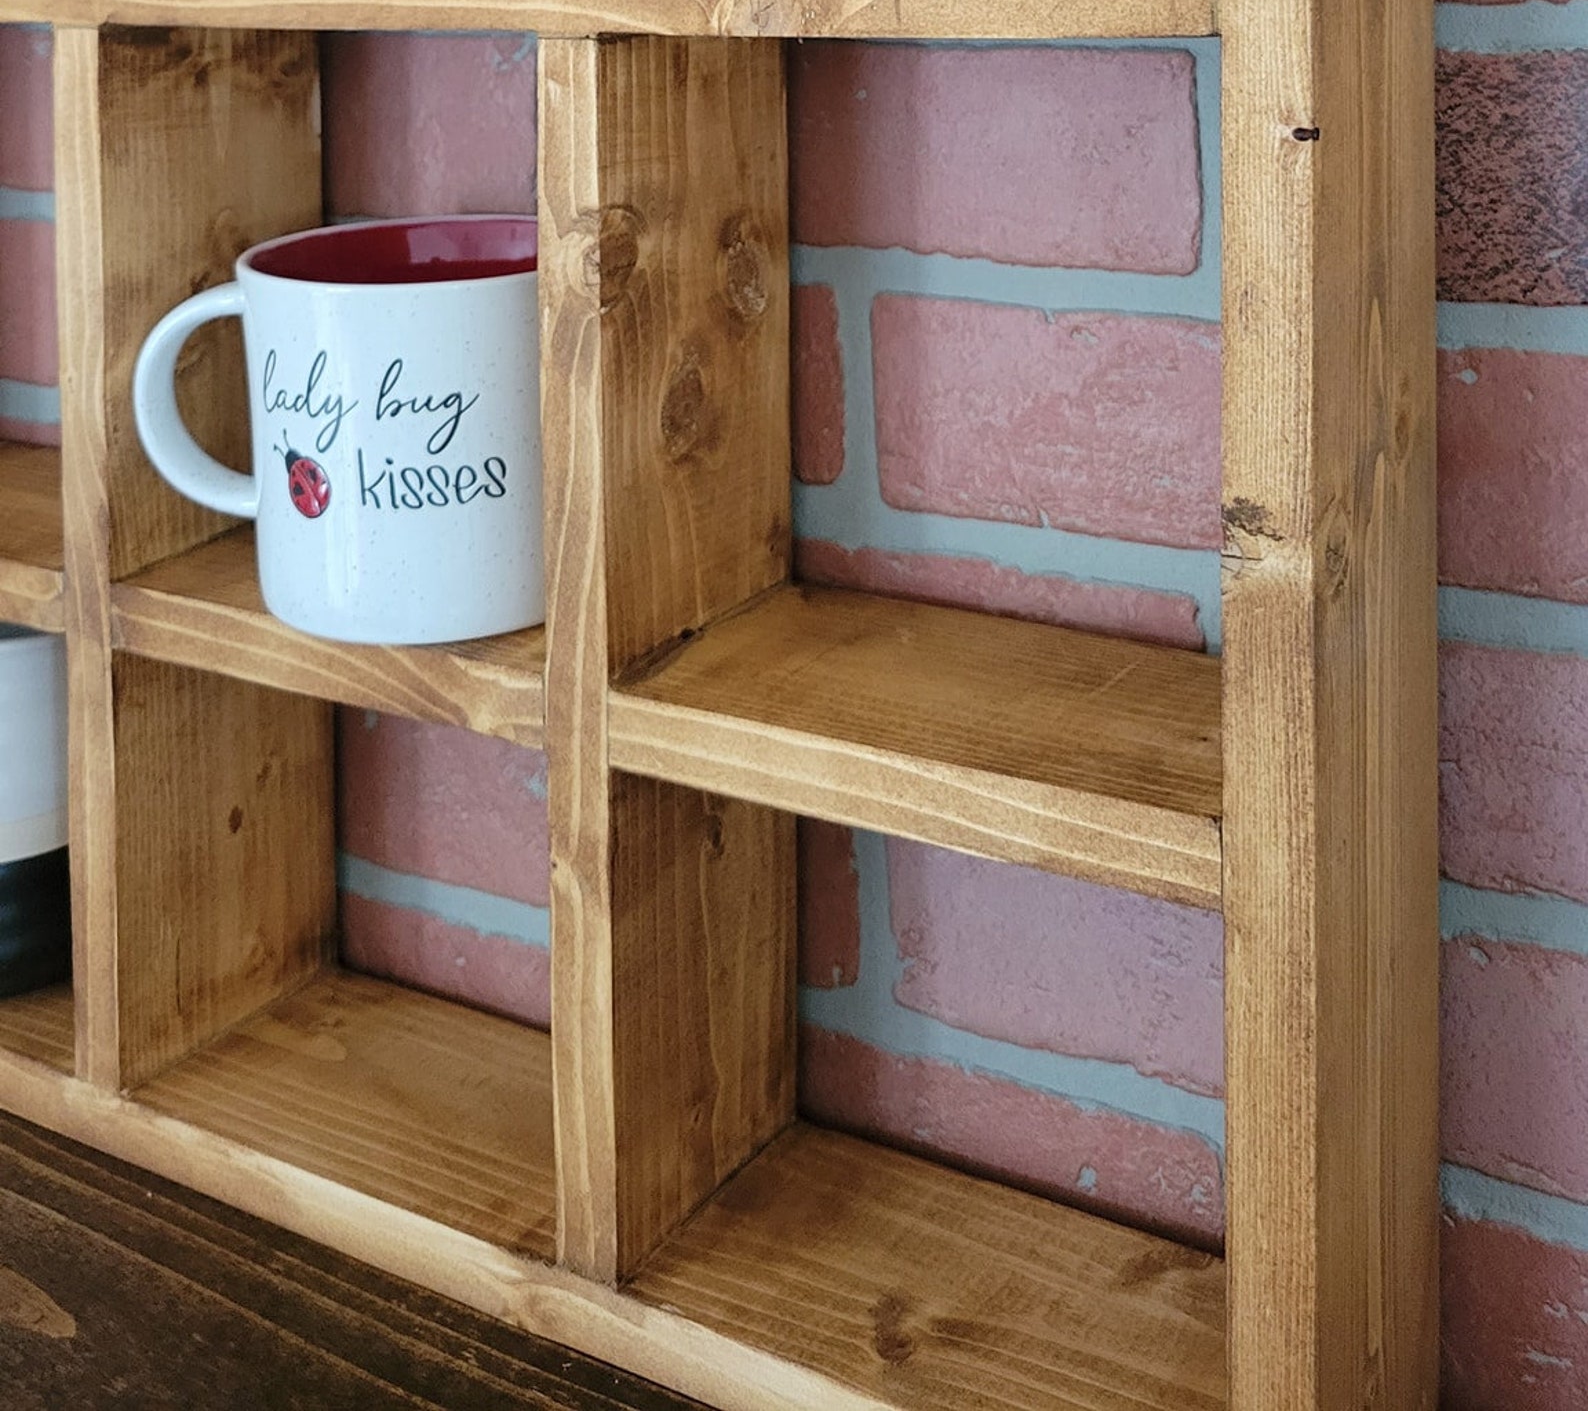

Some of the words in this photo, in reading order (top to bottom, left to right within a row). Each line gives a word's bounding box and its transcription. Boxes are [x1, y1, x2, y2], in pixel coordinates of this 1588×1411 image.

[262, 349, 359, 453] lady
[375, 358, 480, 455] bug
[357, 447, 507, 510] kisses
